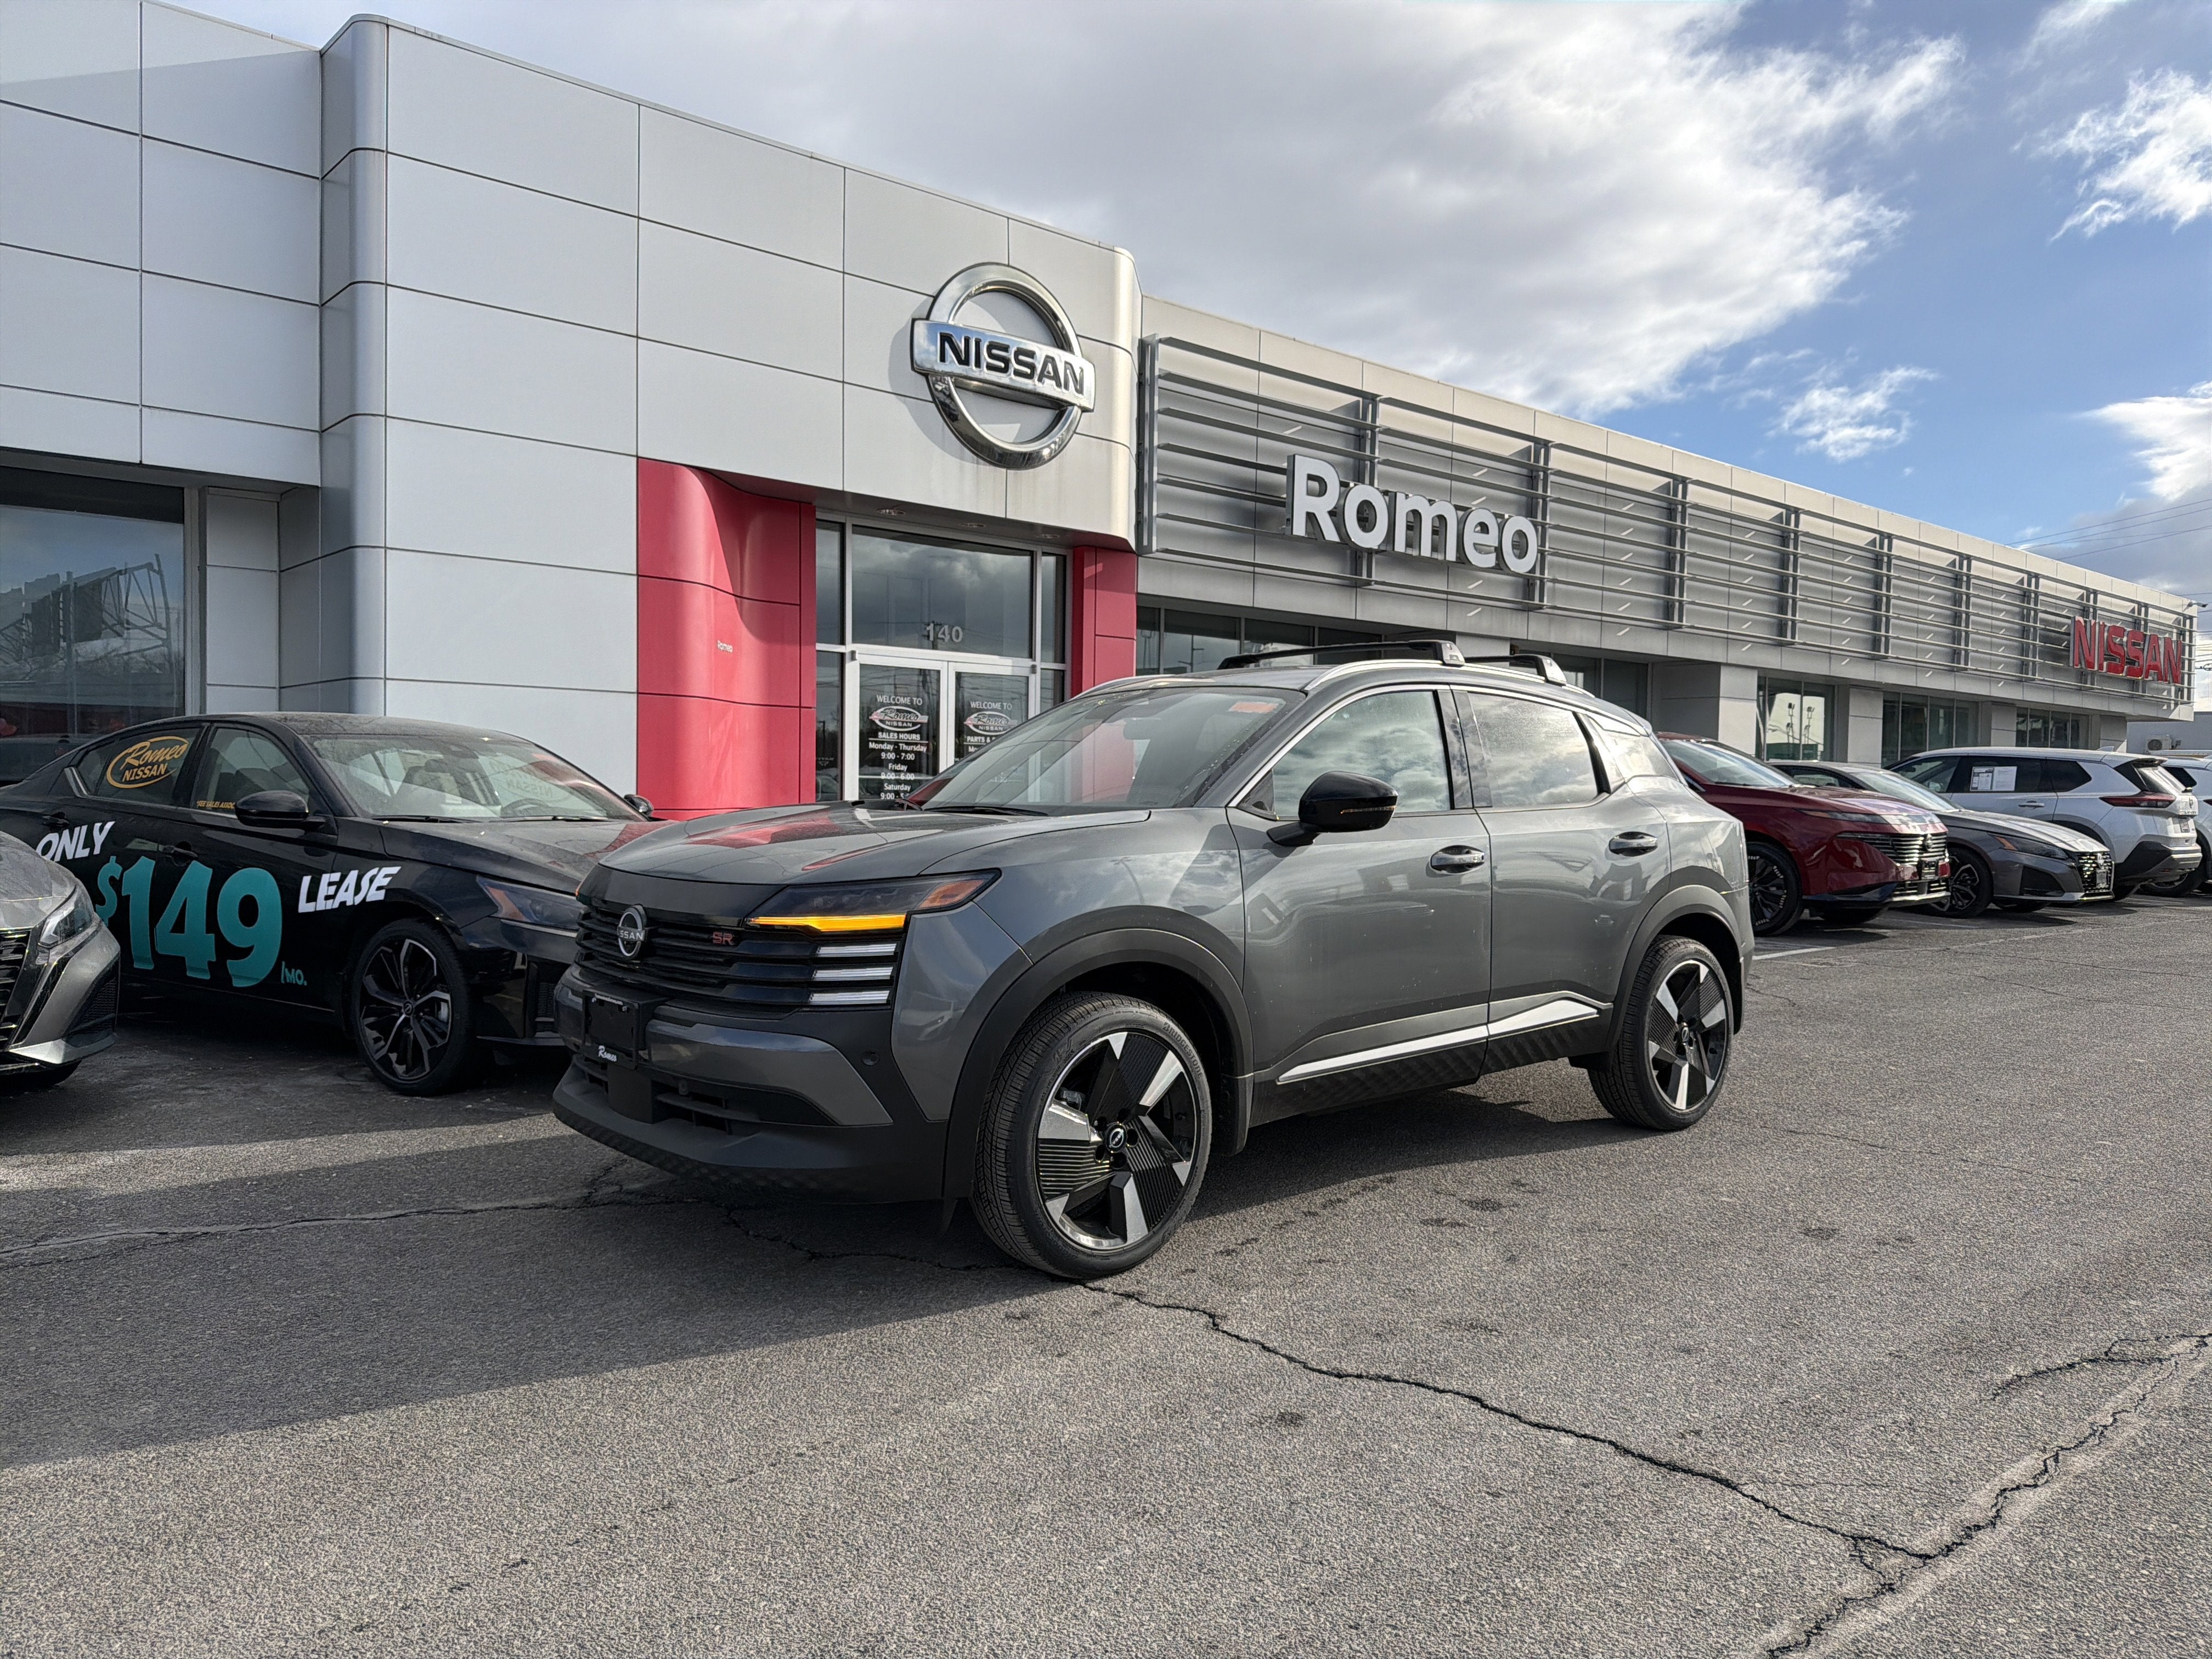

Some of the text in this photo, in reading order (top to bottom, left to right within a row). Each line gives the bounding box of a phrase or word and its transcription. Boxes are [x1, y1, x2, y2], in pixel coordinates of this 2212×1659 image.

[938, 331, 1085, 397] NISSAN
[1286, 454, 1537, 573] Romeo
[926, 623, 963, 643] 140
[2070, 616, 2182, 685] NISSAN
[876, 695, 923, 706] WELCOME TO
[969, 701, 1001, 710] WELCOME
[881, 707, 919, 720] Romeo
[974, 713, 1009, 725] Romeo
[899, 732, 921, 741] HOURS
[120, 741, 188, 770] Romeo
[868, 742, 894, 751] Monday
[899, 743, 927, 753] Thursday
[122, 763, 168, 782] NISSAN
[888, 763, 908, 772] Friday
[883, 782, 911, 792] Saturday
[36, 821, 115, 862] ONLY
[298, 866, 402, 913] LEASE
[95, 855, 283, 988] $149
[620, 929, 644, 940] SSAN
[713, 932, 733, 946] SR
[281, 961, 307, 986] /MO.
[598, 1045, 617, 1062] Romeo
[1162, 1022, 1204, 1079] BRIDGESTONE
